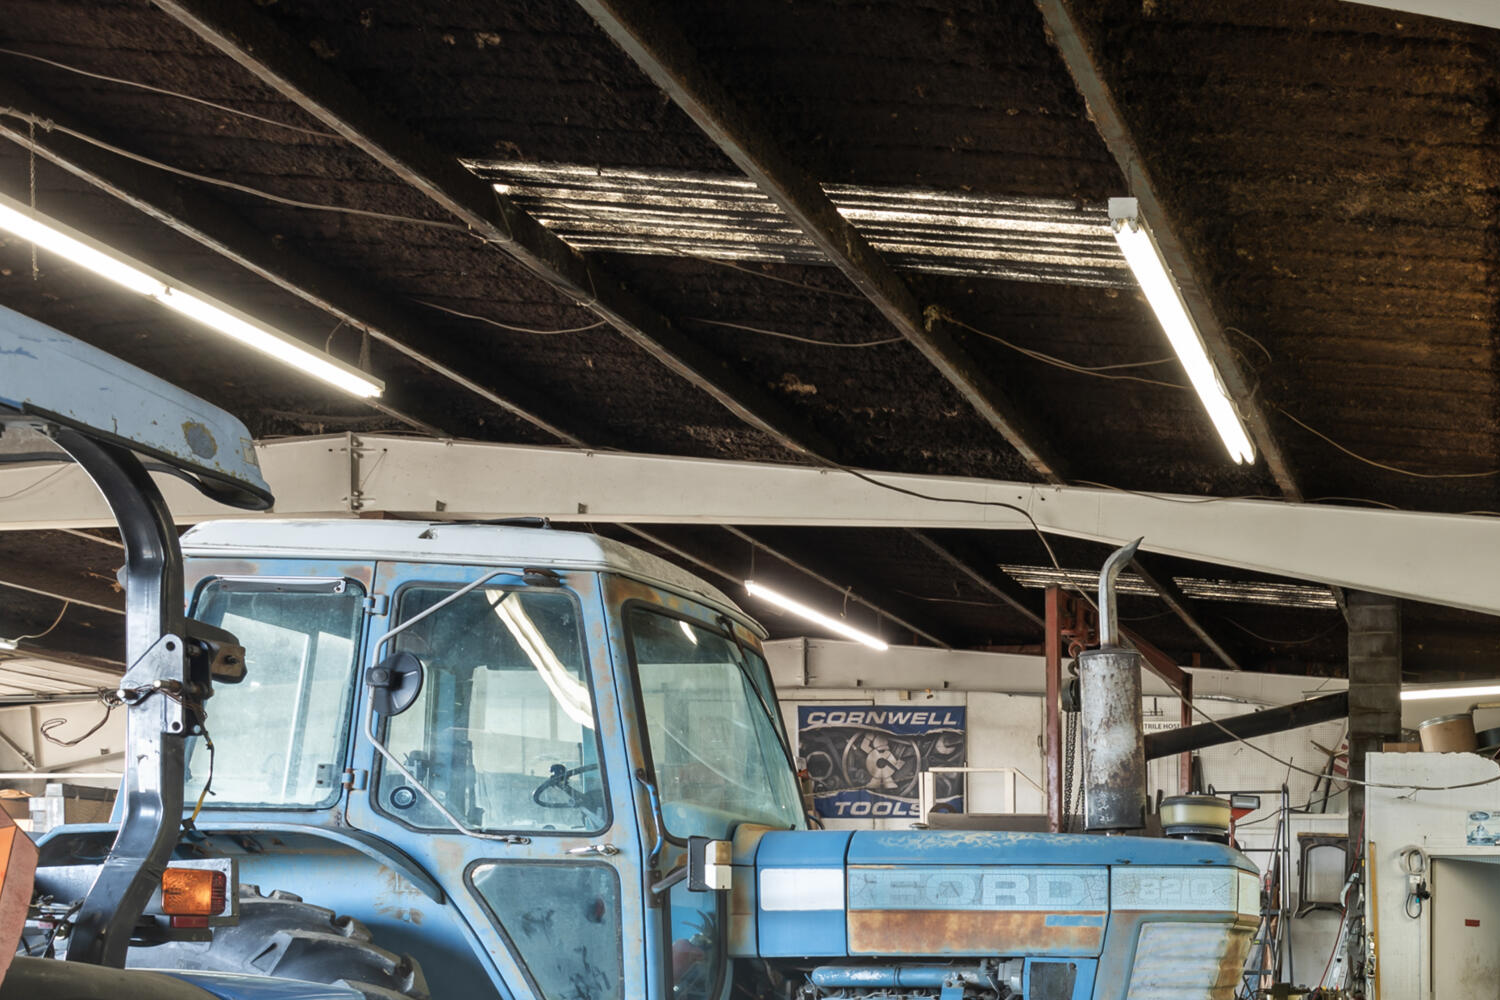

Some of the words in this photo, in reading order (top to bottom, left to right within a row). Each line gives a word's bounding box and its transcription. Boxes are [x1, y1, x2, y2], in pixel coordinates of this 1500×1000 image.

[807, 711, 958, 726] CORNWELL
[834, 801, 921, 817] TOOLS
[889, 873, 1085, 906] FORD
